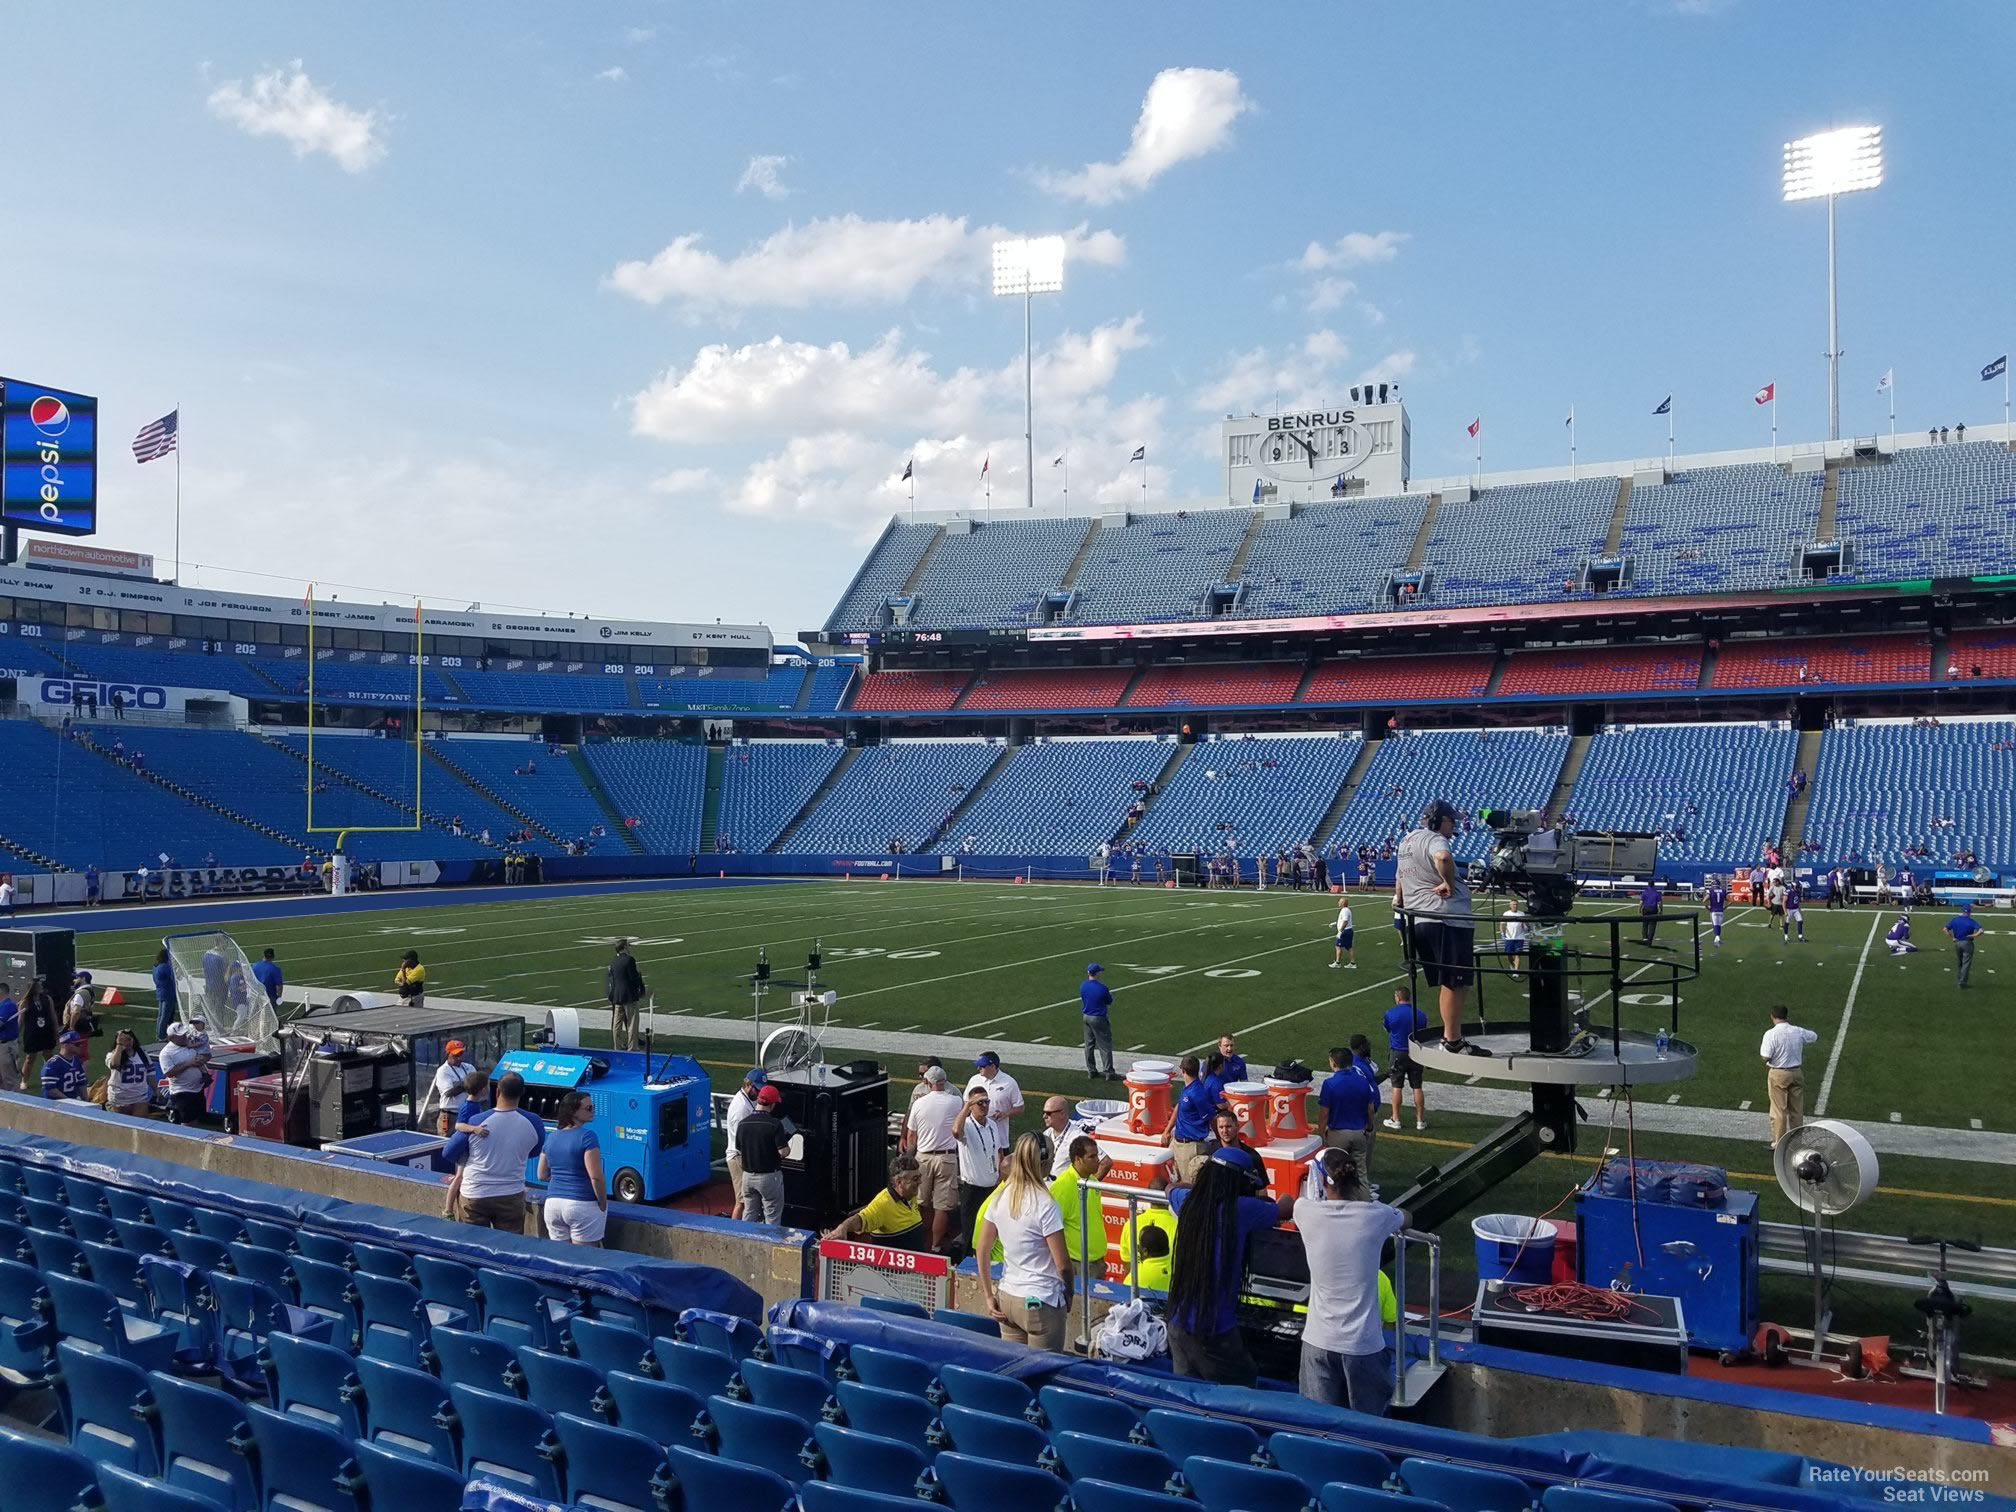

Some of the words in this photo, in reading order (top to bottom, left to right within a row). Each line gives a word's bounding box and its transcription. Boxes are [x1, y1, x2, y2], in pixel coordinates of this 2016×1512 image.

[1268, 410, 1355, 431] BENRUS
[1340, 441, 1349, 454] 3
[1272, 447, 1281, 461] 9
[35, 439, 65, 523] pepsi
[32, 543, 84, 558] northtown
[85, 551, 136, 565] automotive
[24, 581, 54, 590] SHAW
[79, 586, 91, 595] 32
[120, 592, 163, 602] SIMPSON
[183, 598, 193, 606] 12
[221, 603, 272, 613] FERGUSON
[291, 608, 302, 616] 20
[305, 610, 341, 618] ROBERT
[424, 619, 475, 627] ABRAMOSKI
[505, 624, 540, 632] GEORGE
[20, 625, 42, 637] 201
[67, 629, 86, 641] Blue
[101, 632, 120, 644] Blue
[135, 635, 154, 647] Blue
[168, 638, 187, 649] Blue
[914, 633, 942, 642] 76:48
[202, 641, 223, 653] 21
[235, 643, 256, 655] 202
[441, 657, 462, 667] 203
[789, 658, 807, 667] 204
[818, 658, 836, 667] 205
[604, 664, 624, 674] 203
[634, 665, 654, 675] 204
[40, 680, 167, 710] GEICO
[121, 1063, 145, 1084] 25
[1131, 1091, 1146, 1110] G
[1273, 1095, 1290, 1114] G
[1233, 1103, 1249, 1122] G
[626, 1127, 649, 1136] Microsoft
[626, 1133, 643, 1142] Surface
